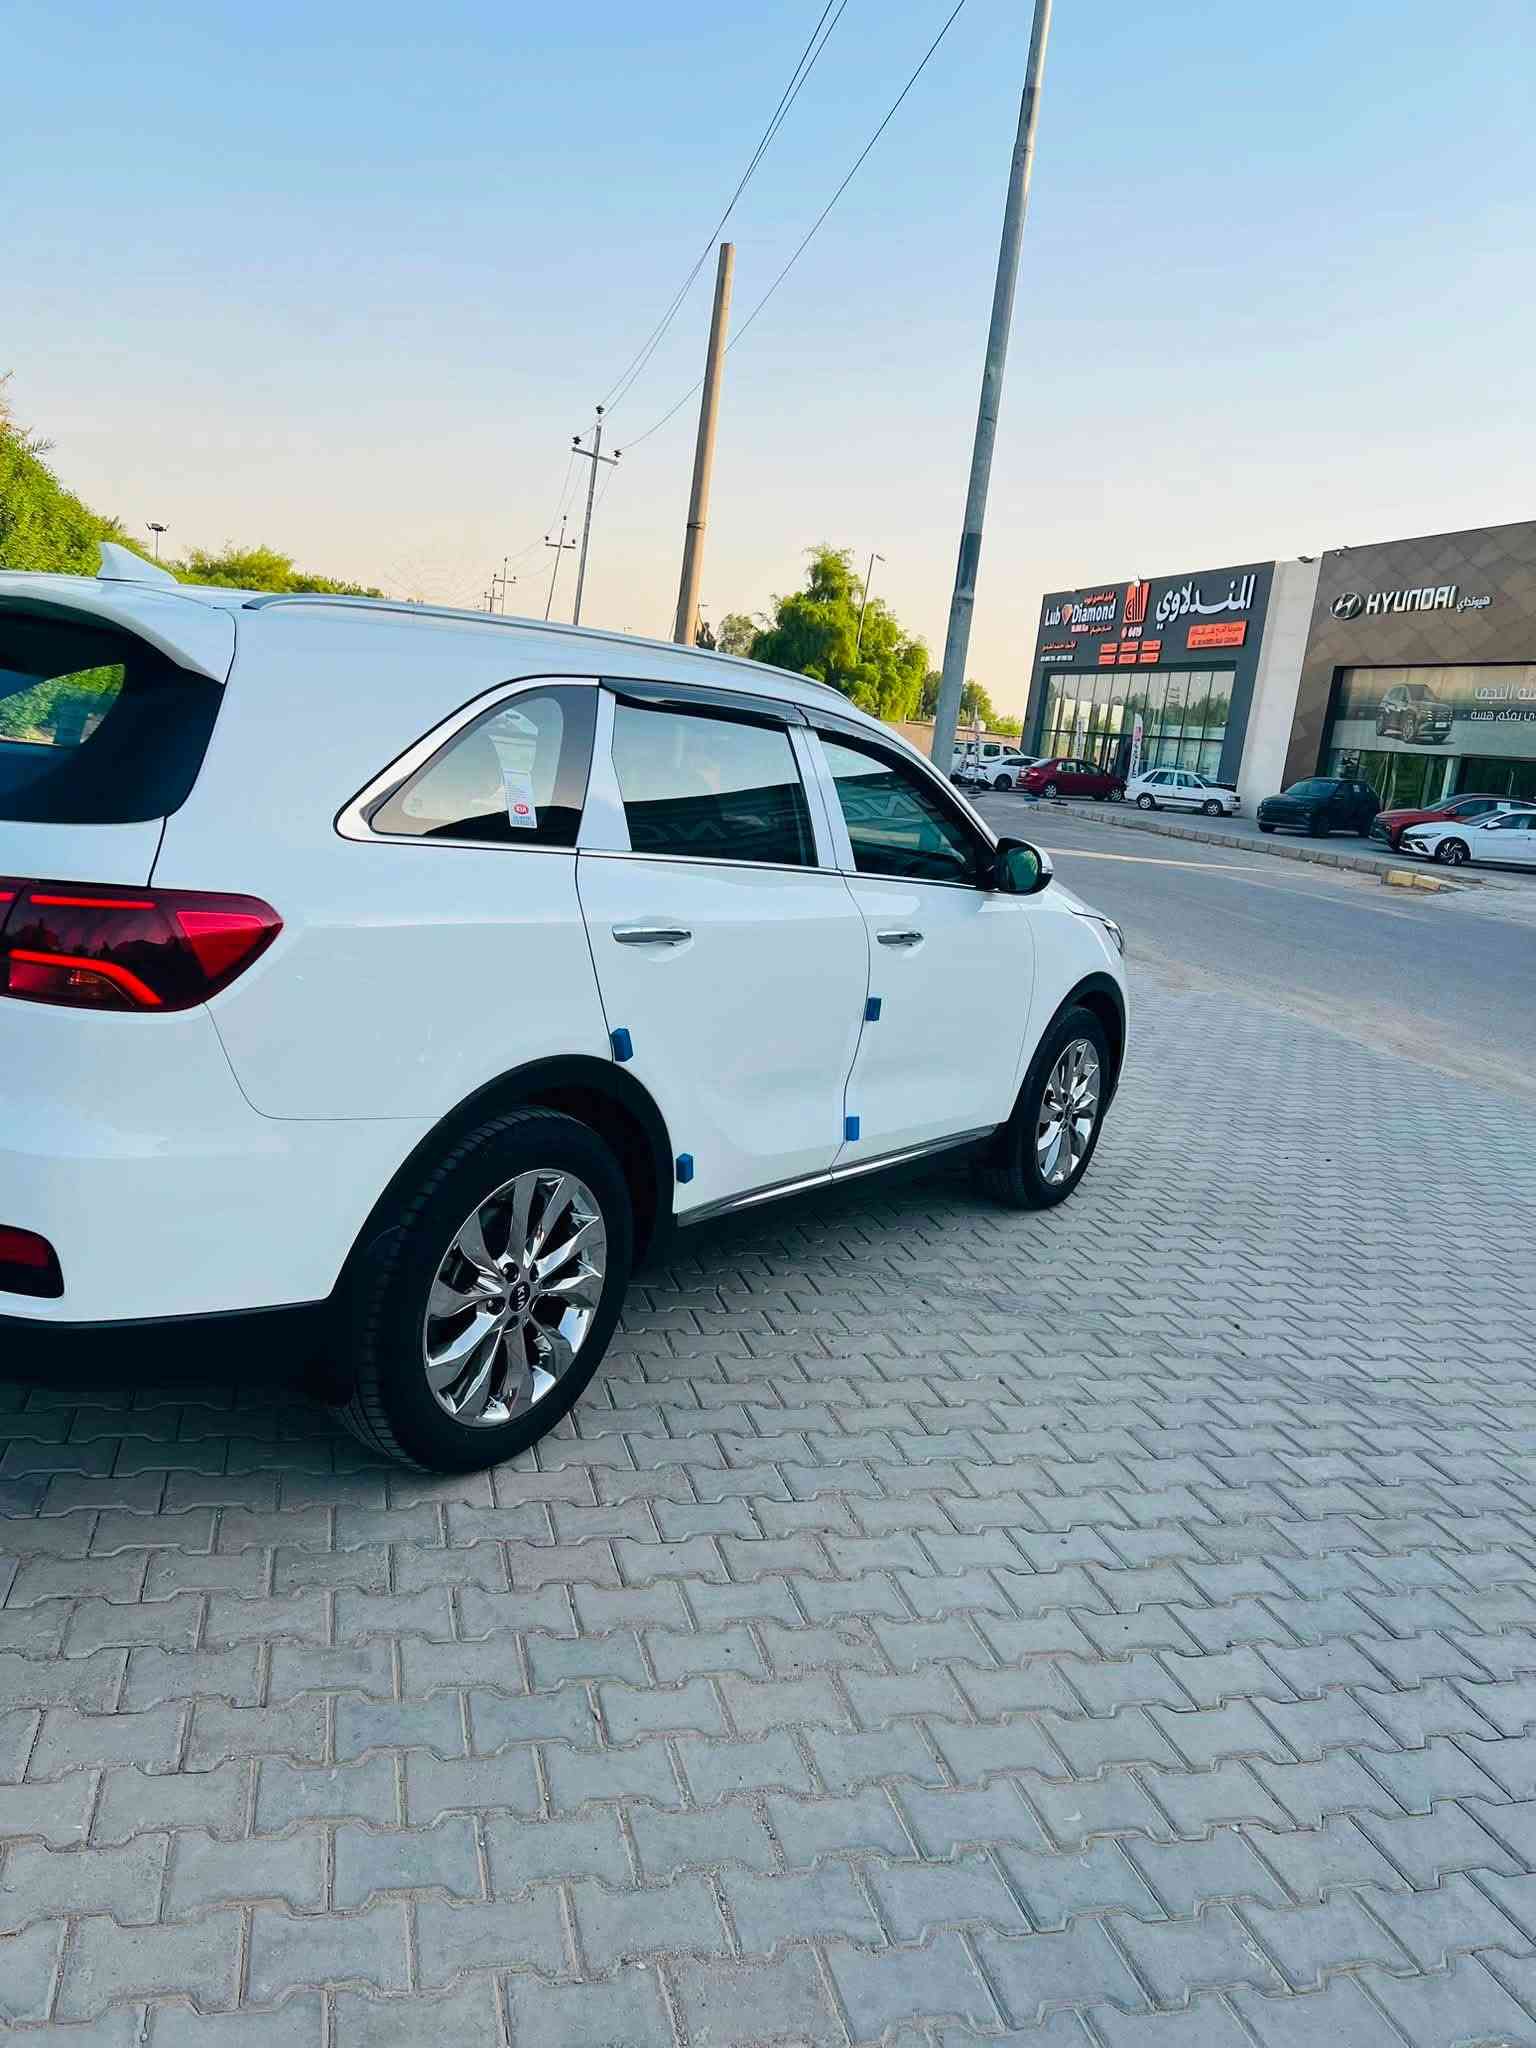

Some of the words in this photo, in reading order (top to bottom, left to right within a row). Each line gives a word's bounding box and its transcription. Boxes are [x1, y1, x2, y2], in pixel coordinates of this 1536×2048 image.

[1044, 608, 1061, 626] Lub
[1071, 598, 1117, 623] Diamond
[1155, 574, 1256, 630] المندلاوي
[1366, 585, 1457, 615] HYUNDAI
[517, 1285, 525, 1310] KIA
